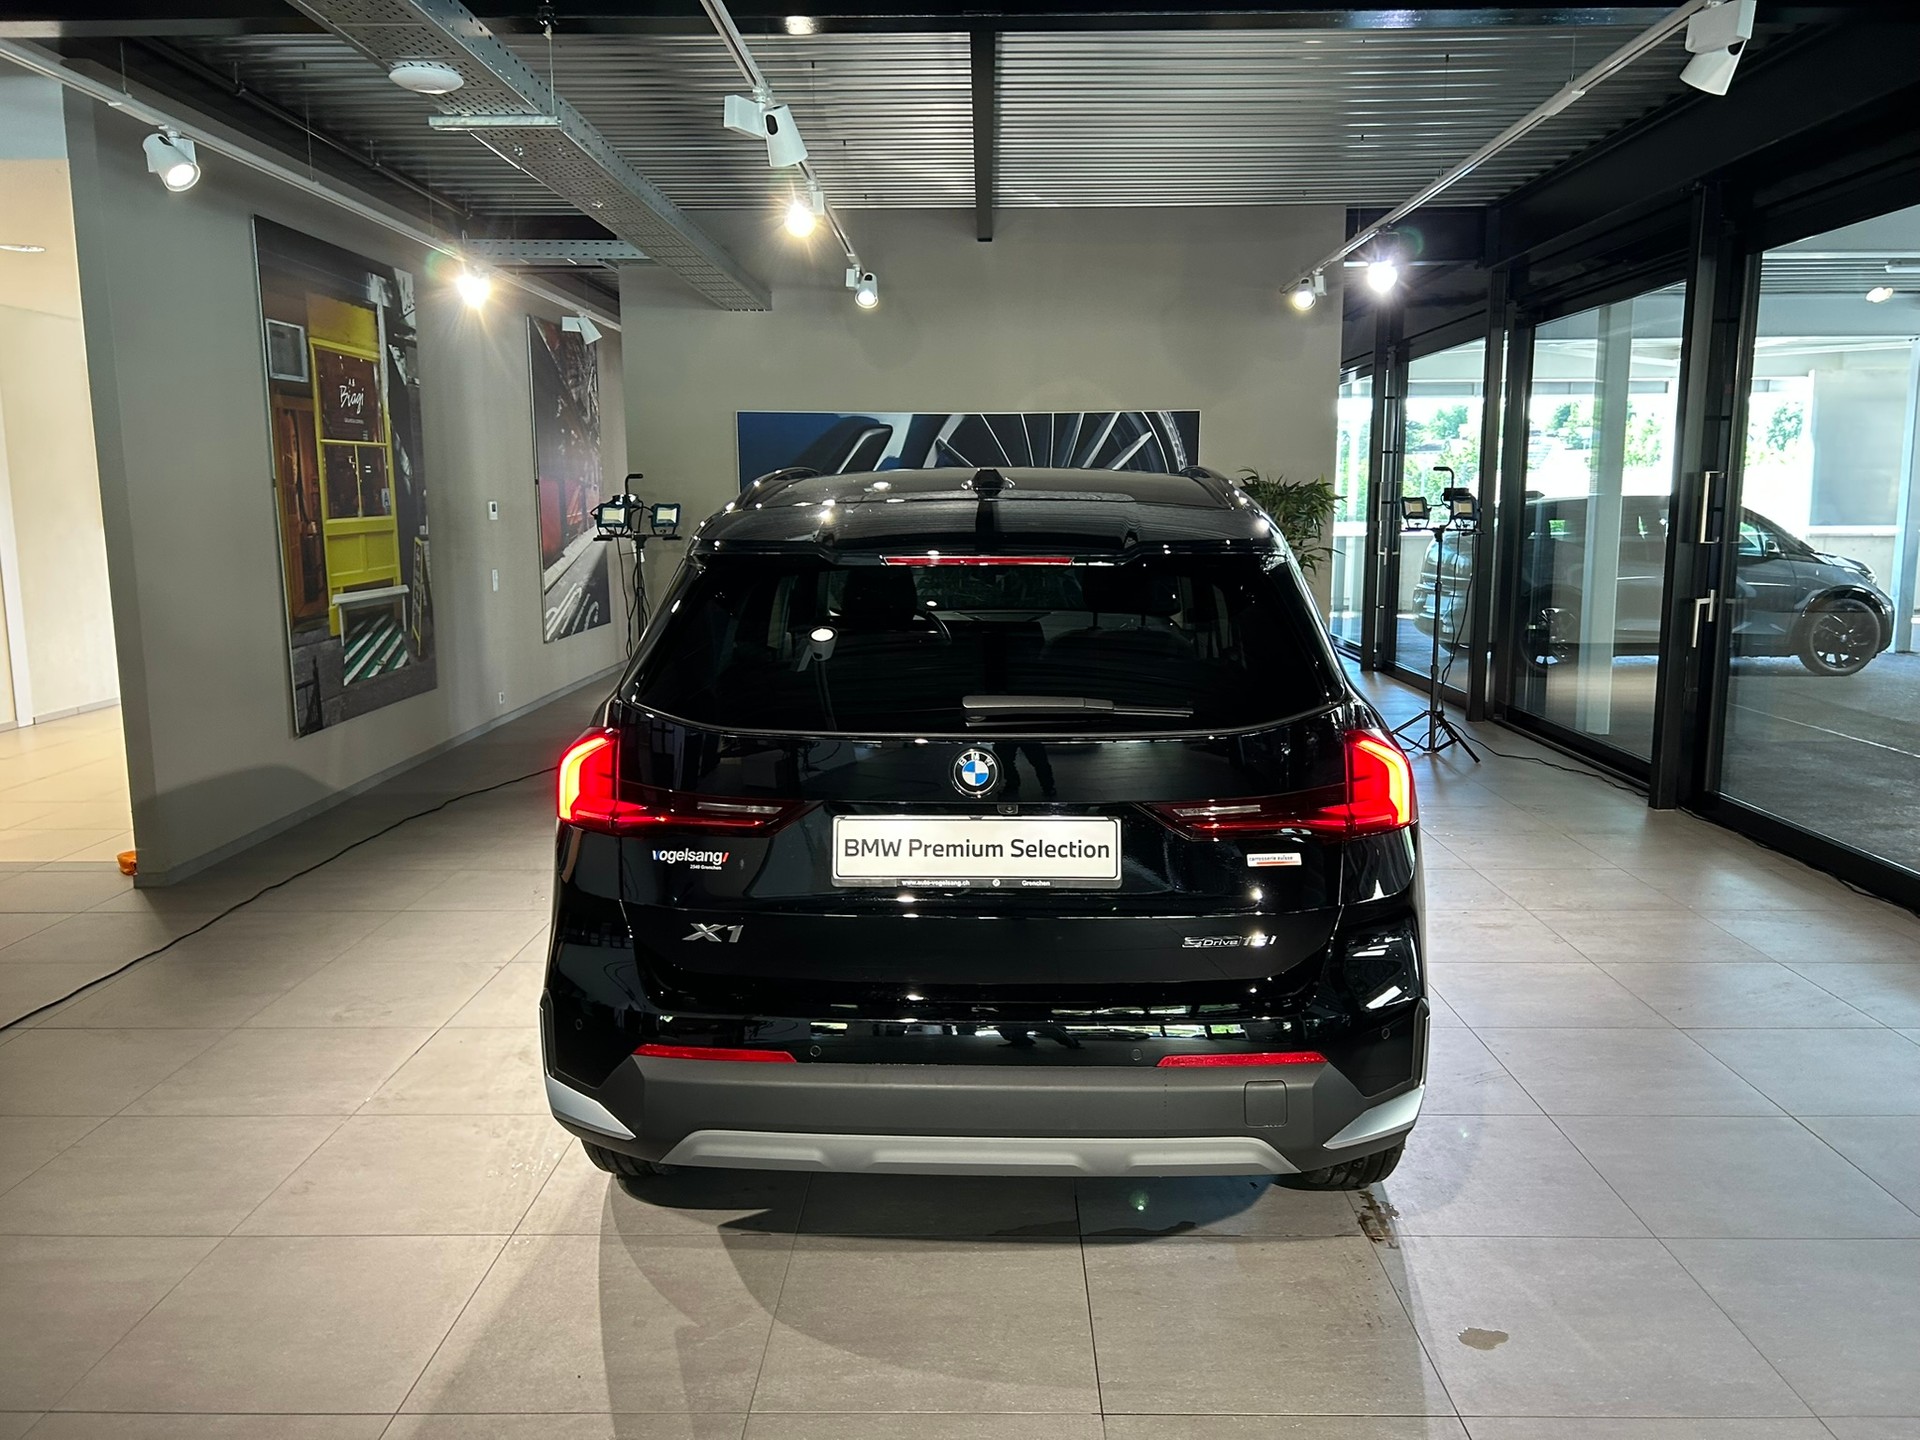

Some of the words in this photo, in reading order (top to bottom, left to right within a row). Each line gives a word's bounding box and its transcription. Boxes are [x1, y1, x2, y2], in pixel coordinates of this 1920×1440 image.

[958, 752, 995, 767] BMW
[844, 838, 902, 857] BMW
[908, 838, 1004, 858] Premium
[1010, 838, 1110, 859] Selection
[901, 879, 971, 888] www.auto-vogelsang.ch
[1021, 879, 1051, 887] Grenchen
[682, 923, 744, 943] X1
